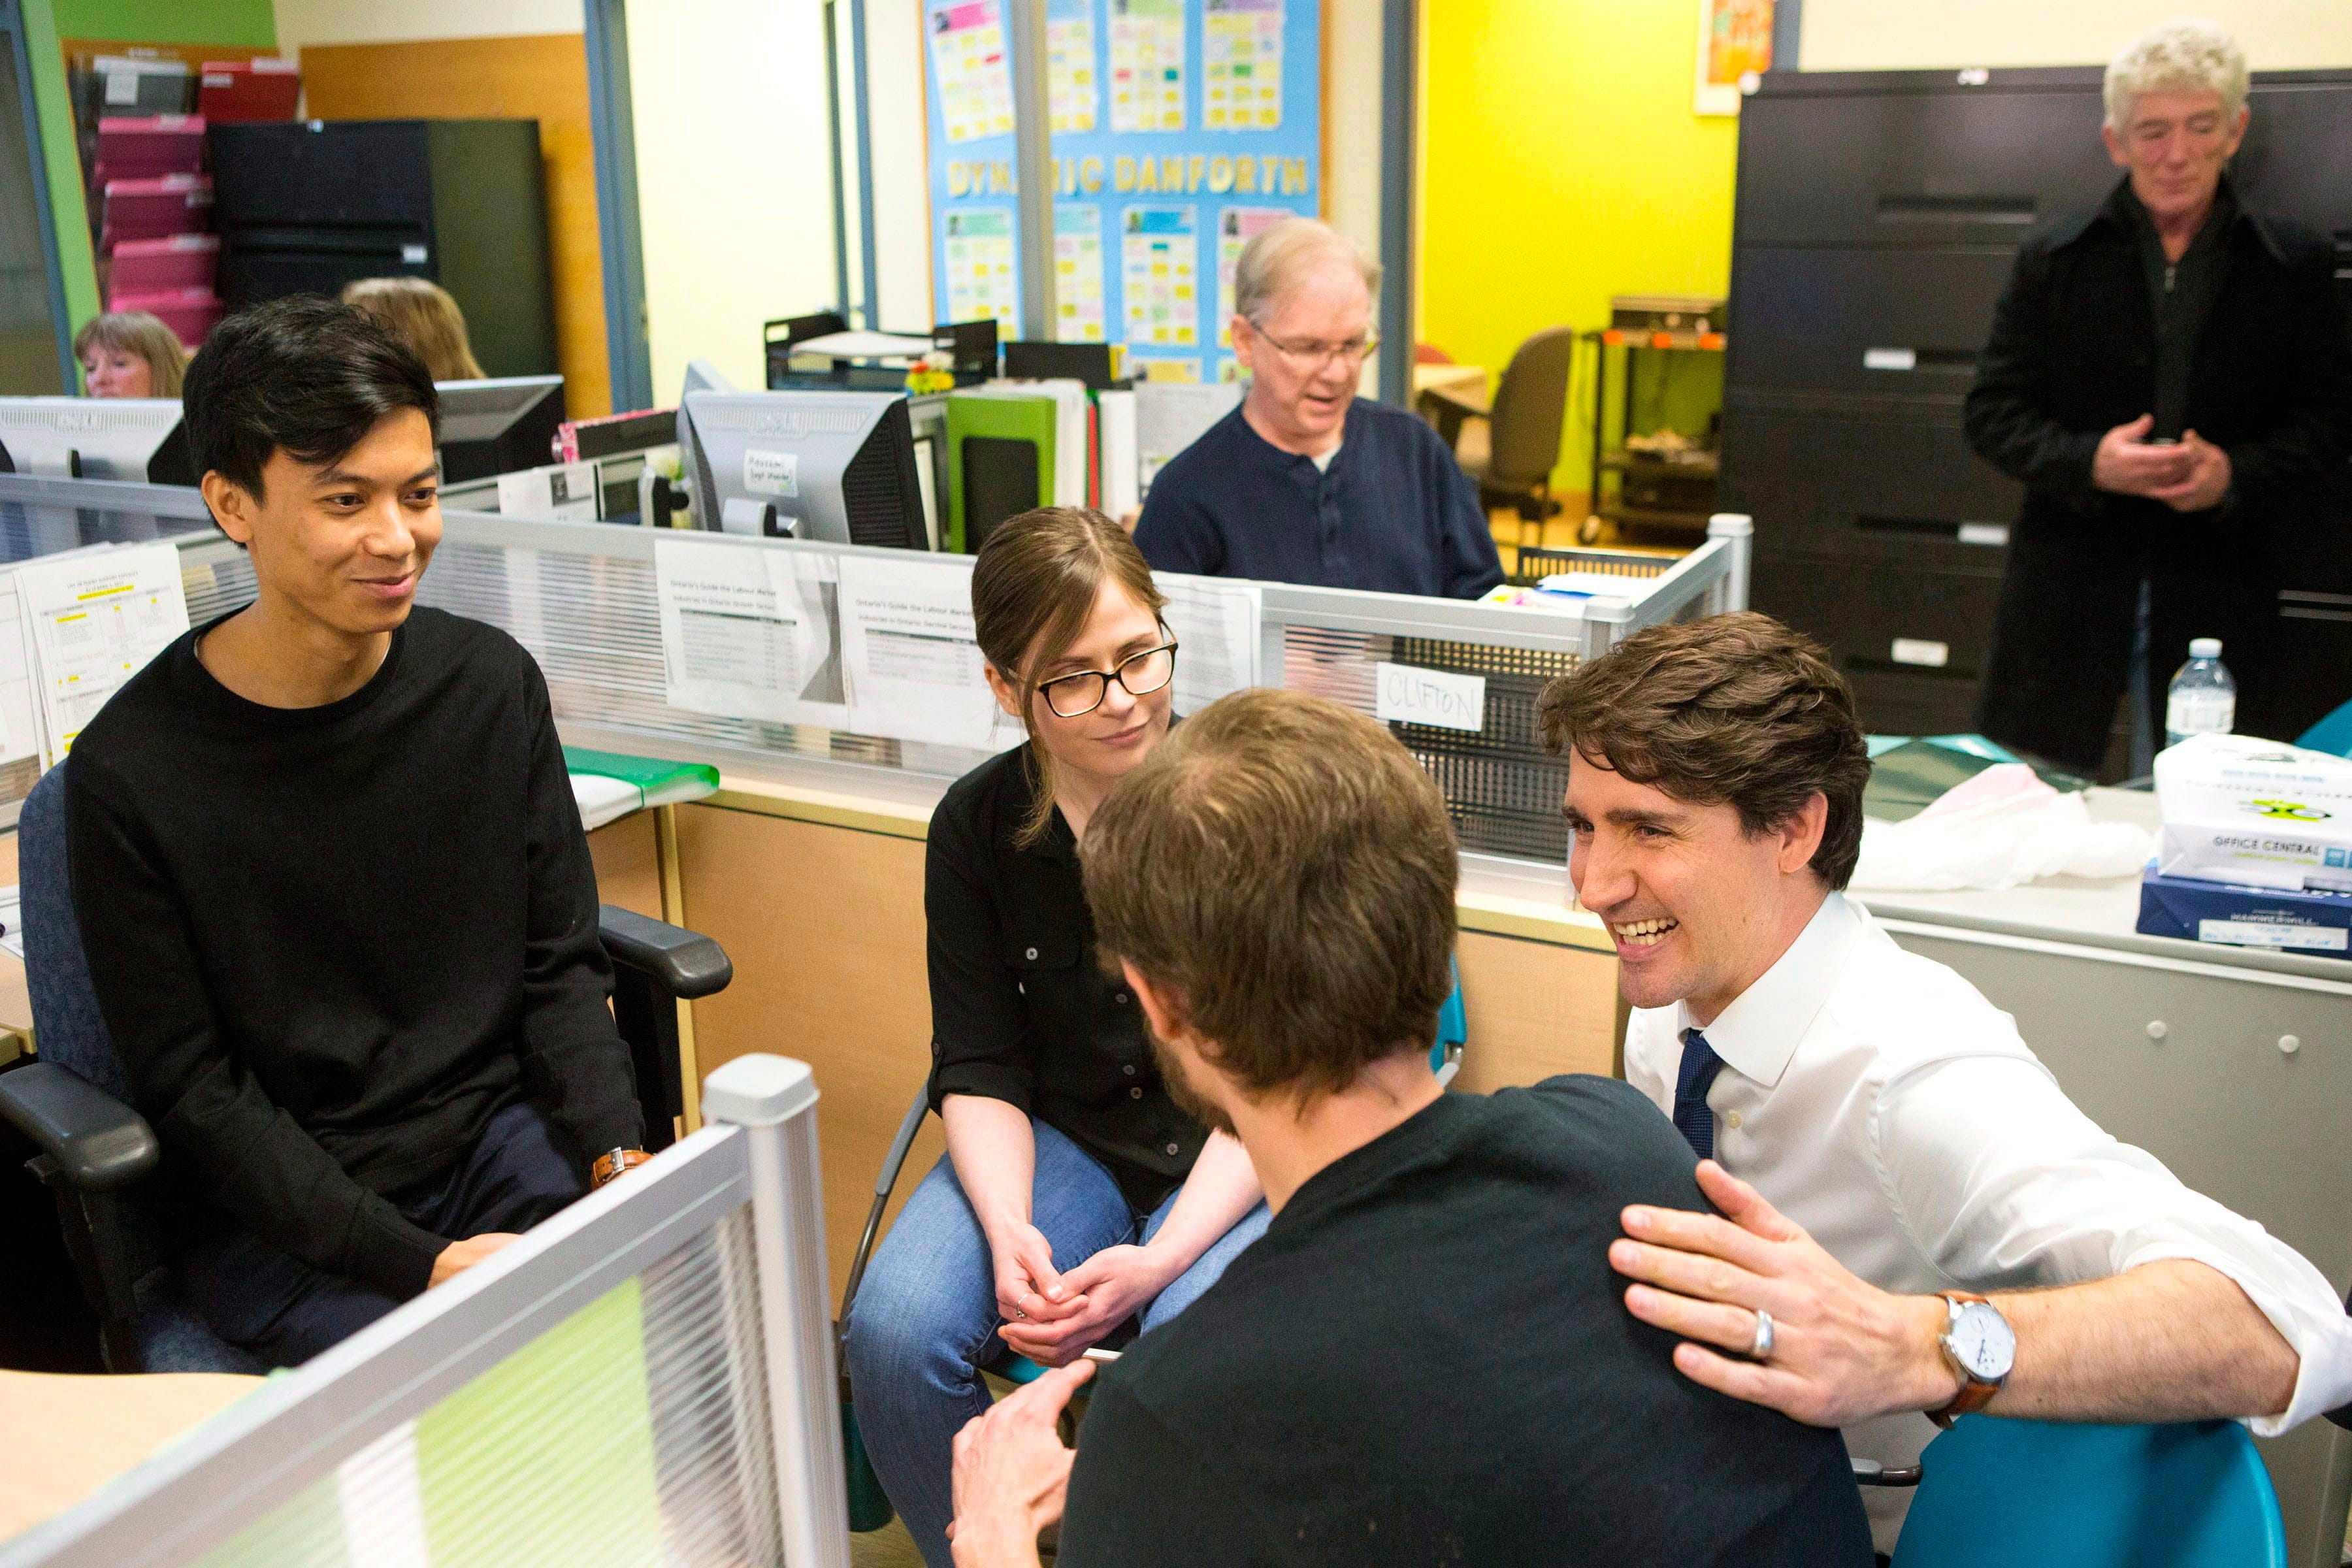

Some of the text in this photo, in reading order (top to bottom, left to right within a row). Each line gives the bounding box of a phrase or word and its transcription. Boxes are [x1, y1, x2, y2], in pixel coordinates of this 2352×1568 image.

[947, 155, 1307, 195] DYNIC DANFORTH
[855, 598, 886, 608] Ontario's
[888, 601, 908, 610] Guide
[923, 606, 947, 614] Labour
[1387, 672, 1477, 727] CLIFTON
[2214, 836, 2320, 857] OFFICE CENTRAL
